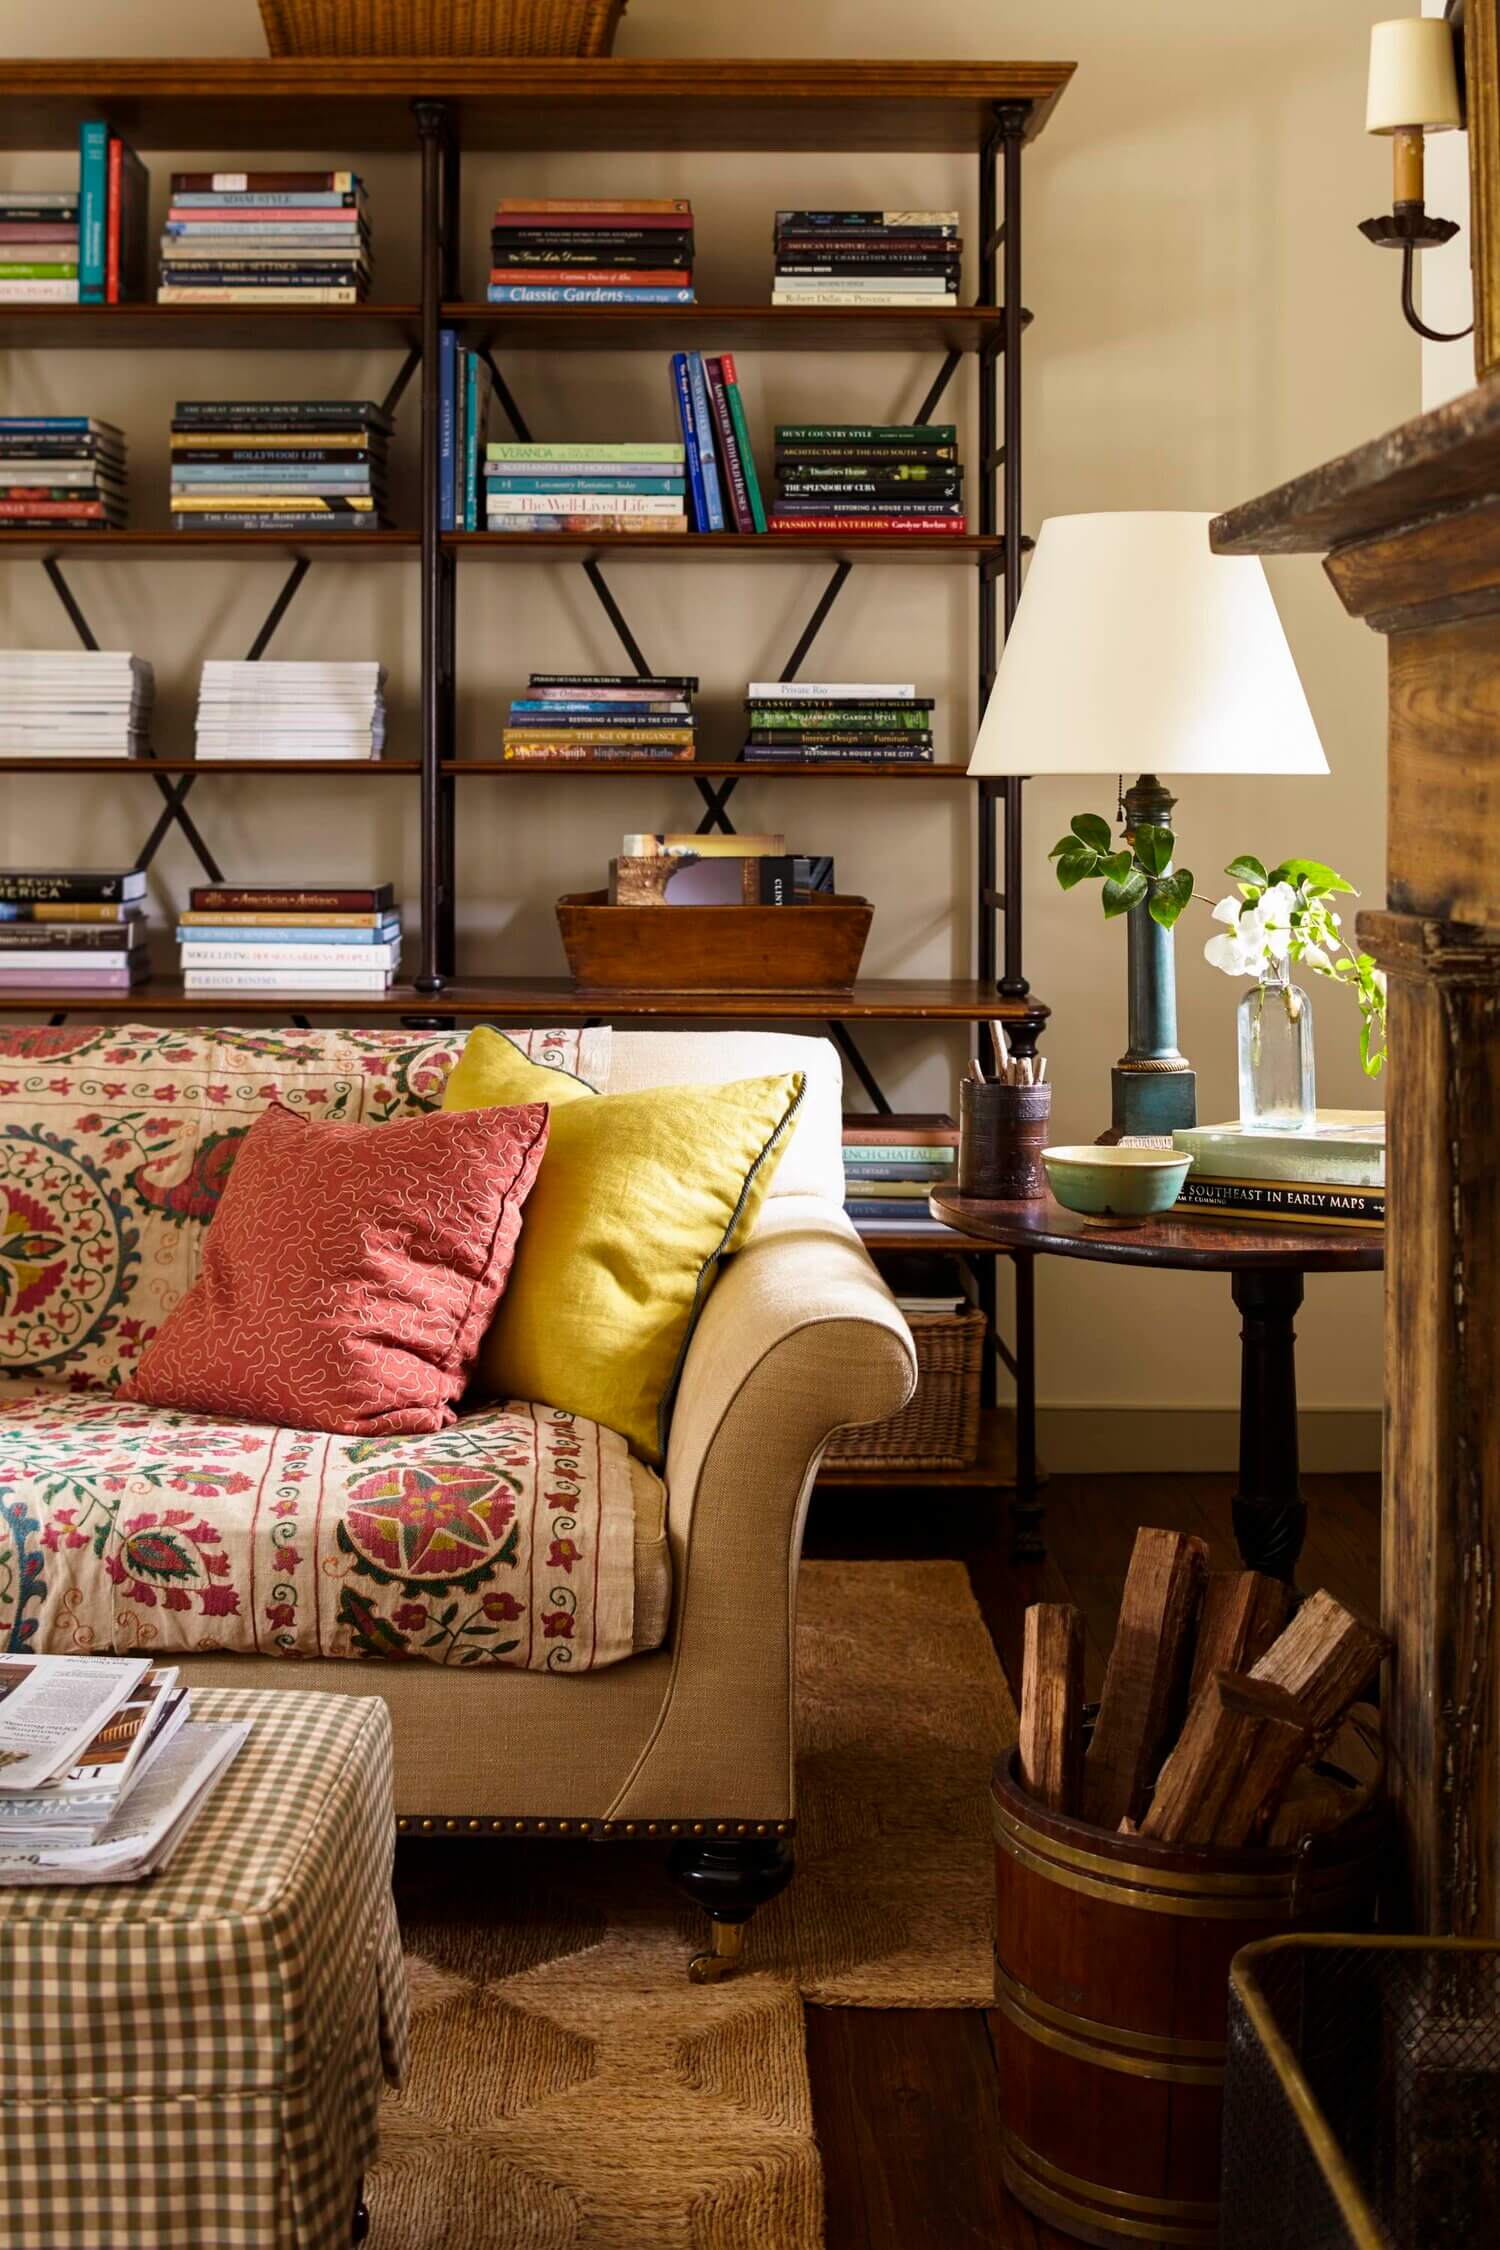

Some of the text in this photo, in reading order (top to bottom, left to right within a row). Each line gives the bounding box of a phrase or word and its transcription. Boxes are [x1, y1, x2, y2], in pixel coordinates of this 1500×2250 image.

[509, 287, 560, 302] Classic
[563, 288, 624, 302] Gardens
[786, 293, 815, 303] Robert
[712, 381, 733, 435] ADVENTURES
[782, 431, 806, 439] HUNT
[808, 431, 847, 439] COUNTRY
[849, 431, 873, 439] STYLE
[723, 434, 738, 458] WITH
[233, 452, 326, 461] HOLLYWOOD LIFE
[500, 447, 553, 459] VERANDA
[784, 449, 918, 457] ARCHITECTURE OF THE OLD SOUTH
[728, 458, 742, 479] OLD
[784, 484, 876, 493] THE SPLENDOR OF CUBA
[732, 477, 749, 511] HOUSES
[519, 498, 649, 512] The Well-Lived Life
[204, 513, 221, 521] THE
[273, 513, 306, 521] ROBERT
[309, 513, 335, 521] ADAM
[770, 521, 778, 529] A
[779, 521, 816, 529] PASSION
[818, 521, 837, 529] FOR
[838, 521, 890, 529] INTERIORS
[780, 686, 810, 695] Private
[749, 700, 793, 708] CLASSIC
[799, 700, 833, 708] STYLE
[790, 712, 829, 721] WILLIAMS
[841, 712, 872, 721] GARDEN
[873, 712, 897, 721] STYLE
[576, 732, 676, 741] THE AGE OF ELEGANCE
[802, 734, 909, 744] Interior Design Furniture
[558, 746, 587, 757] Smith
[804, 750, 841, 758] RESTORING
[848, 750, 872, 758] HOUSE
[883, 750, 896, 758] THE
[897, 750, 914, 758] CITY
[18, 878, 73, 888] REVIVAL
[239, 893, 339, 906] American Antiques
[191, 976, 277, 986] PERIOD ROOMS
[876, 1149, 932, 1161] CHATEAU
[1189, 1185, 1366, 1211] SOUTHEAST IN EARLY MAPS
[1195, 1198, 1227, 1206] CUMMING
